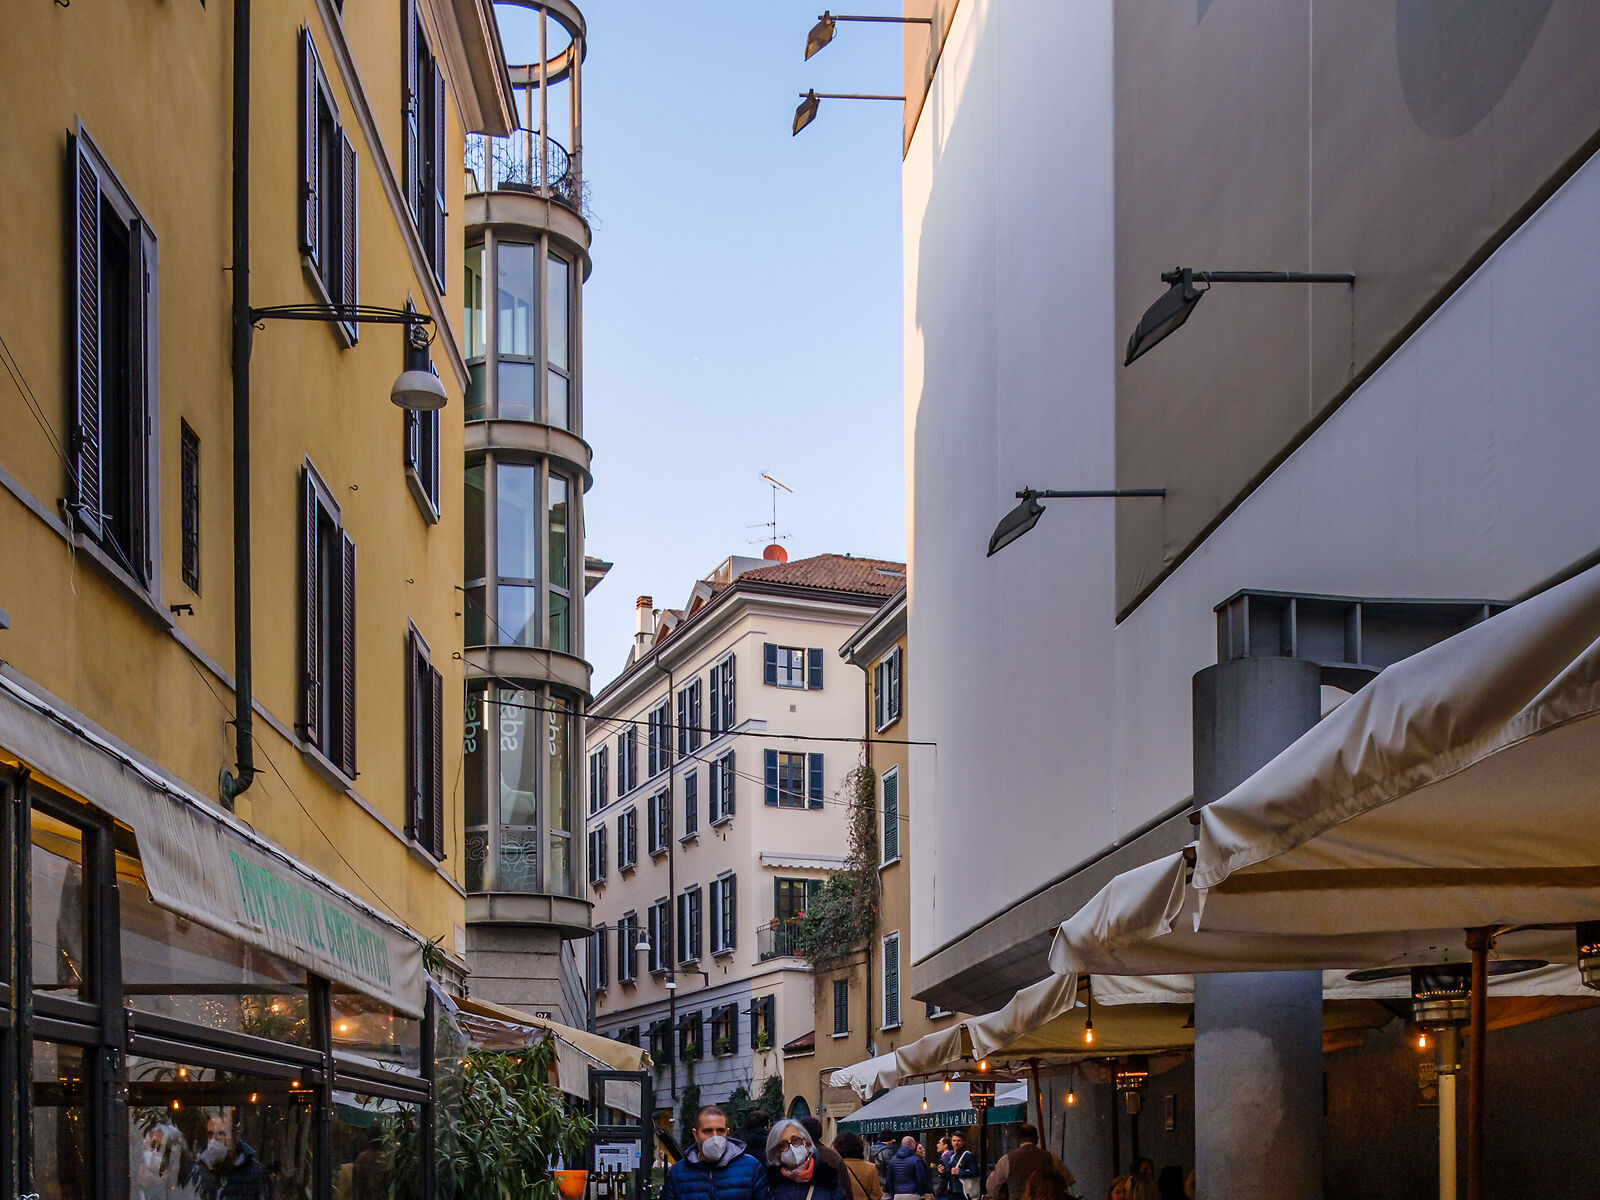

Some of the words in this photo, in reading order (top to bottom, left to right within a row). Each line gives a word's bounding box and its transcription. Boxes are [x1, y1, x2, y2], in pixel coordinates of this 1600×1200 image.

[297, 888, 326, 950] DEL
[321, 902, 360, 974] BORGO
[860, 1121, 897, 1132] Ristorante
[900, 1121, 912, 1130] con
